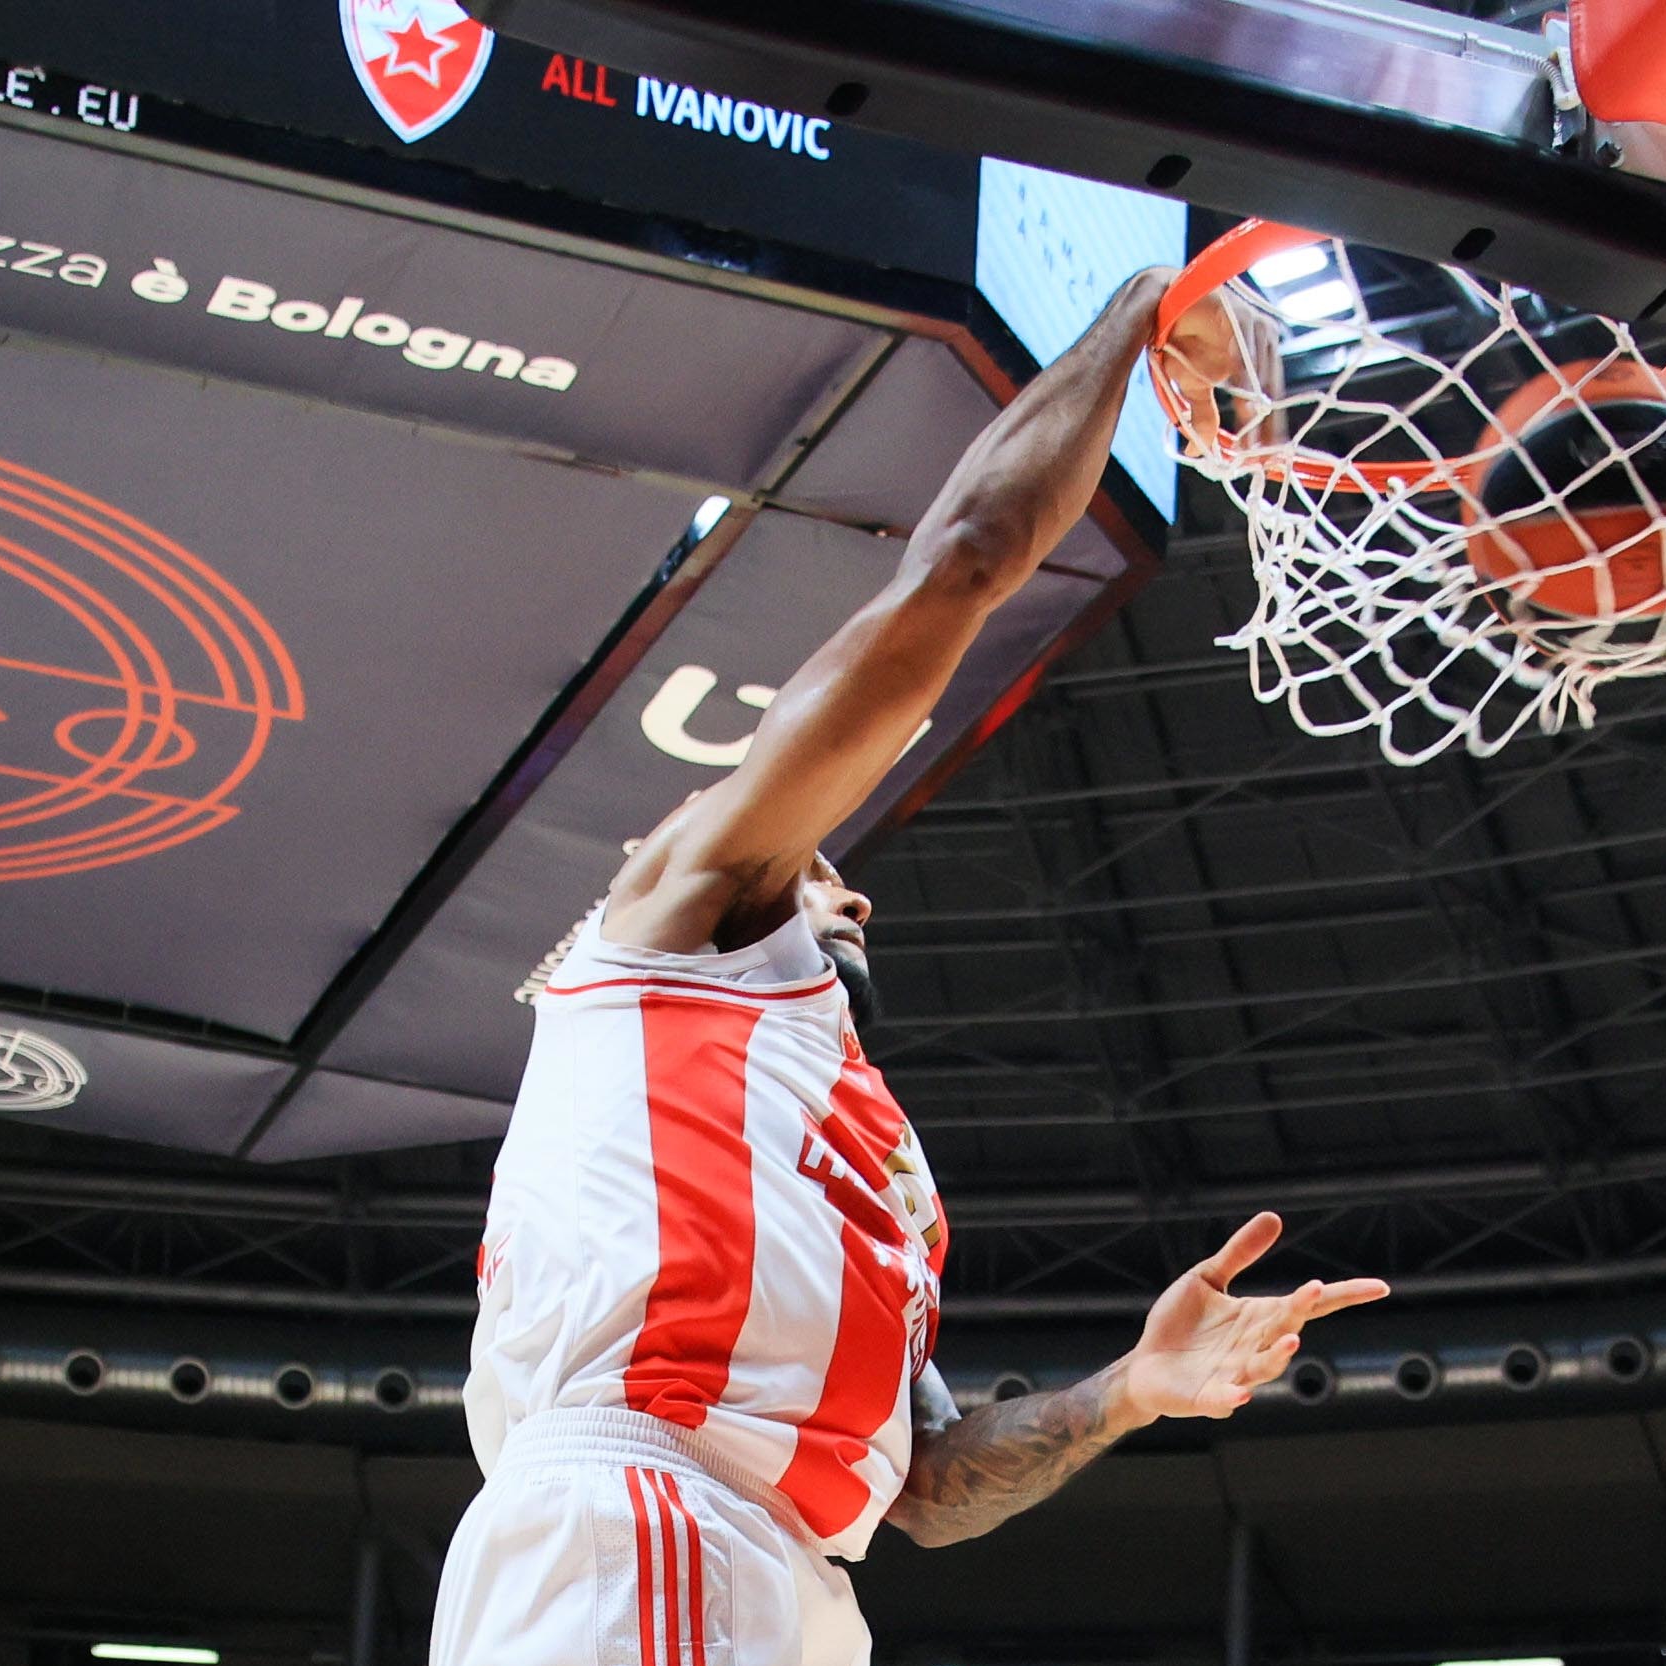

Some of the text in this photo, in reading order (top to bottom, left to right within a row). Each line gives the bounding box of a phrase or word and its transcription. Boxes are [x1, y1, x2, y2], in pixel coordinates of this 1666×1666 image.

[541, 54, 830, 160] ALL IVANOVIC
[131, 259, 190, 304] è
[206, 275, 578, 392] Bologna
